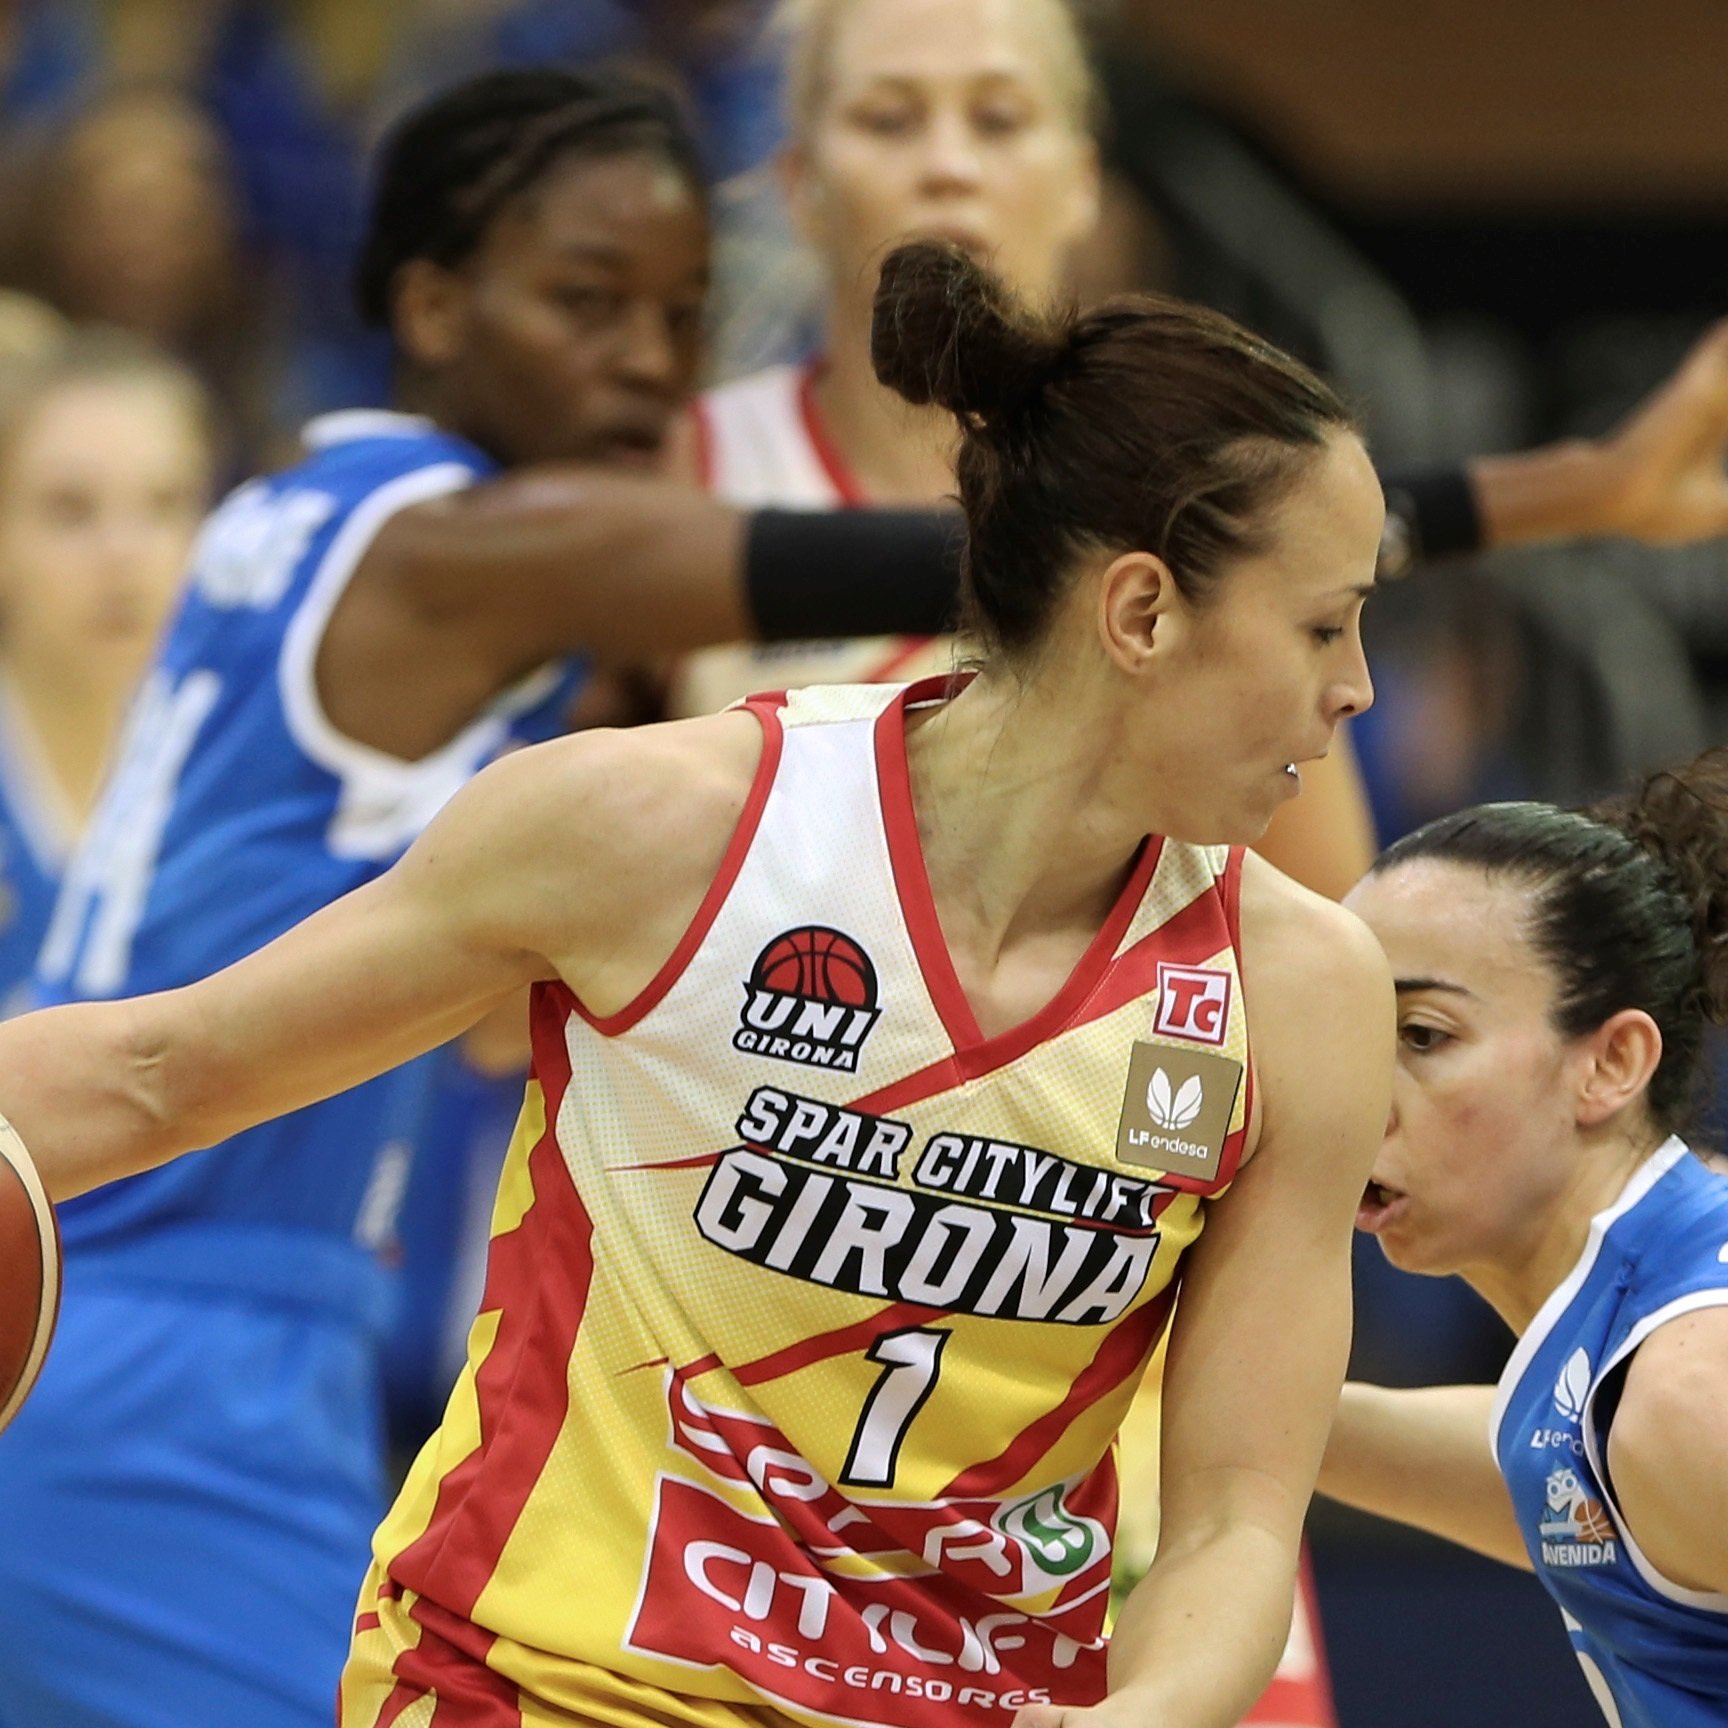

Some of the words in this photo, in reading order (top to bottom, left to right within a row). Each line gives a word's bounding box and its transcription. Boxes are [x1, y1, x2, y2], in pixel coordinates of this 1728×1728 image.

[746, 990, 872, 1045] UNI
[1166, 976, 1222, 1033] Tc
[736, 1029, 855, 1070] GIRONA
[739, 1088, 909, 1178] SPAR
[916, 1134, 1176, 1229] CITYLIFT
[696, 1149, 1159, 1323] GIRONA
[846, 1329, 950, 1488] 1
[1541, 1540, 1617, 1566] AVENIDA
